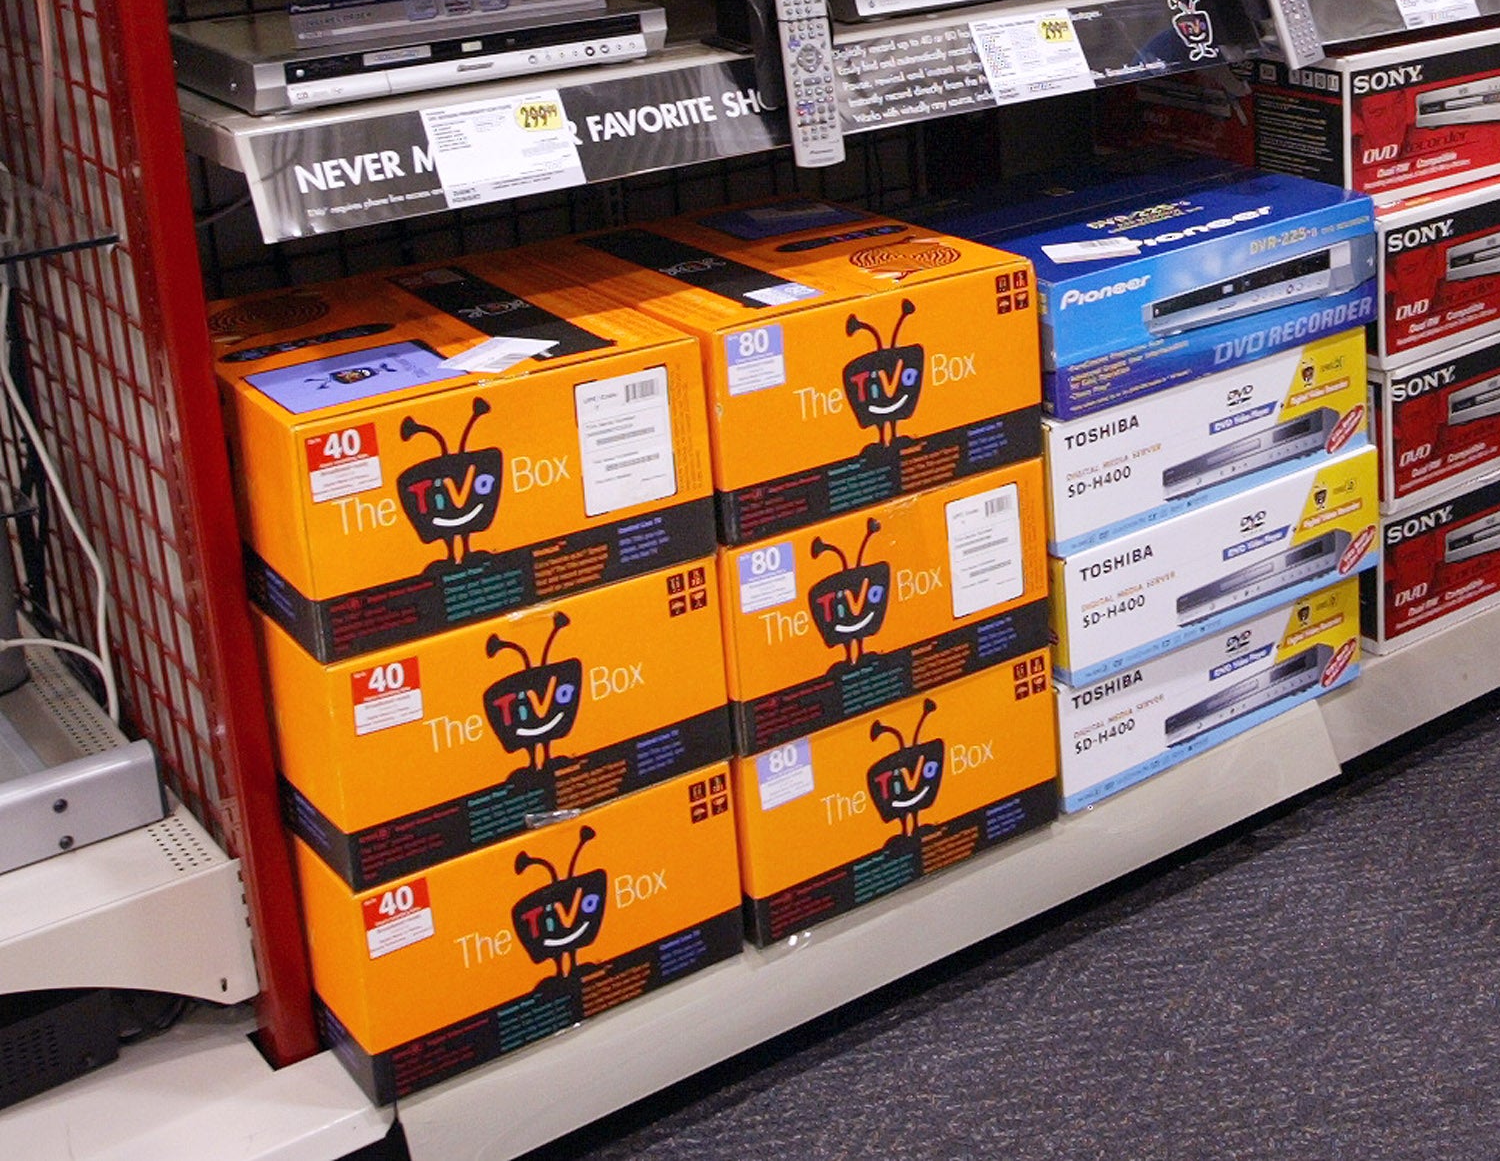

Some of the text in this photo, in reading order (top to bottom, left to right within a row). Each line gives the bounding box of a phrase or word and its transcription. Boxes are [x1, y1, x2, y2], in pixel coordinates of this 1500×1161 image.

[1352, 65, 1422, 95] SONY
[294, 150, 406, 194] NEVER
[586, 94, 718, 144] FAVORITE
[1362, 143, 1398, 165] DVD
[1387, 218, 1454, 253] SONY
[1060, 274, 1151, 310] Pioneer
[1395, 298, 1430, 322] DVD
[740, 328, 770, 357] 80
[1214, 330, 1268, 364] DVD
[1268, 296, 1373, 349] RECORDER
[794, 351, 977, 423] The TiVo Box
[1391, 364, 1456, 402] SONY
[323, 429, 361, 459] 40
[1064, 414, 1140, 451] TOSHIBA
[1399, 442, 1431, 468] DVD
[330, 454, 571, 536] The TiVo Box
[1067, 464, 1132, 499] SD-H400
[1386, 504, 1455, 545] SONY
[750, 546, 782, 575] 80
[1080, 543, 1154, 582] TOSHIBA
[759, 566, 943, 647] The TiVo Box
[1082, 594, 1146, 629] SD-H400
[1394, 582, 1429, 608] DVD
[367, 661, 405, 693] 40
[1071, 669, 1144, 712] TOSHIBA
[425, 662, 645, 754] The TiVo Box
[1074, 717, 1137, 755] SD-H400
[768, 744, 797, 774] 80
[820, 739, 995, 826] The TiVo Box
[379, 883, 416, 915] 40
[456, 867, 668, 971] The TiVo Box
